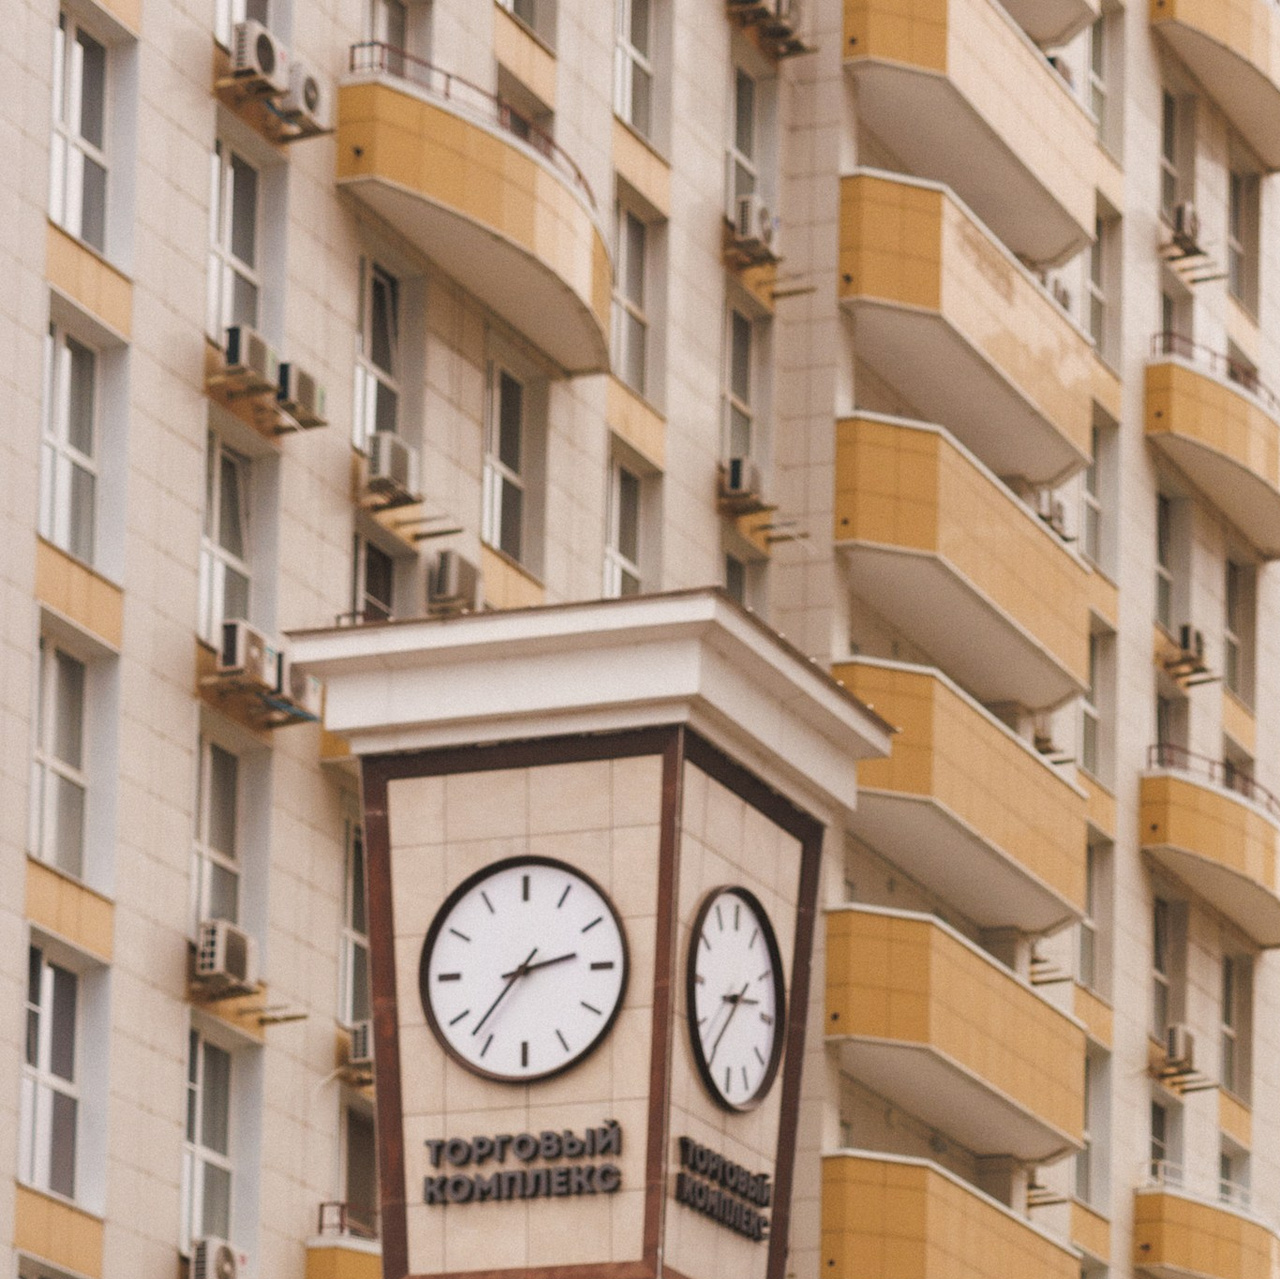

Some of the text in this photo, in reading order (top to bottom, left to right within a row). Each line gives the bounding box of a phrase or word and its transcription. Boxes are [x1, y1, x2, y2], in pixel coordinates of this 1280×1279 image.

[424, 1119, 622, 1168] ТОРГОВЫЙ
[678, 1136, 772, 1208] ТОРГОВЫЙ
[423, 1163, 622, 1206] КОМПЛЕКС
[676, 1173, 770, 1242] КОМПЛЕКС
